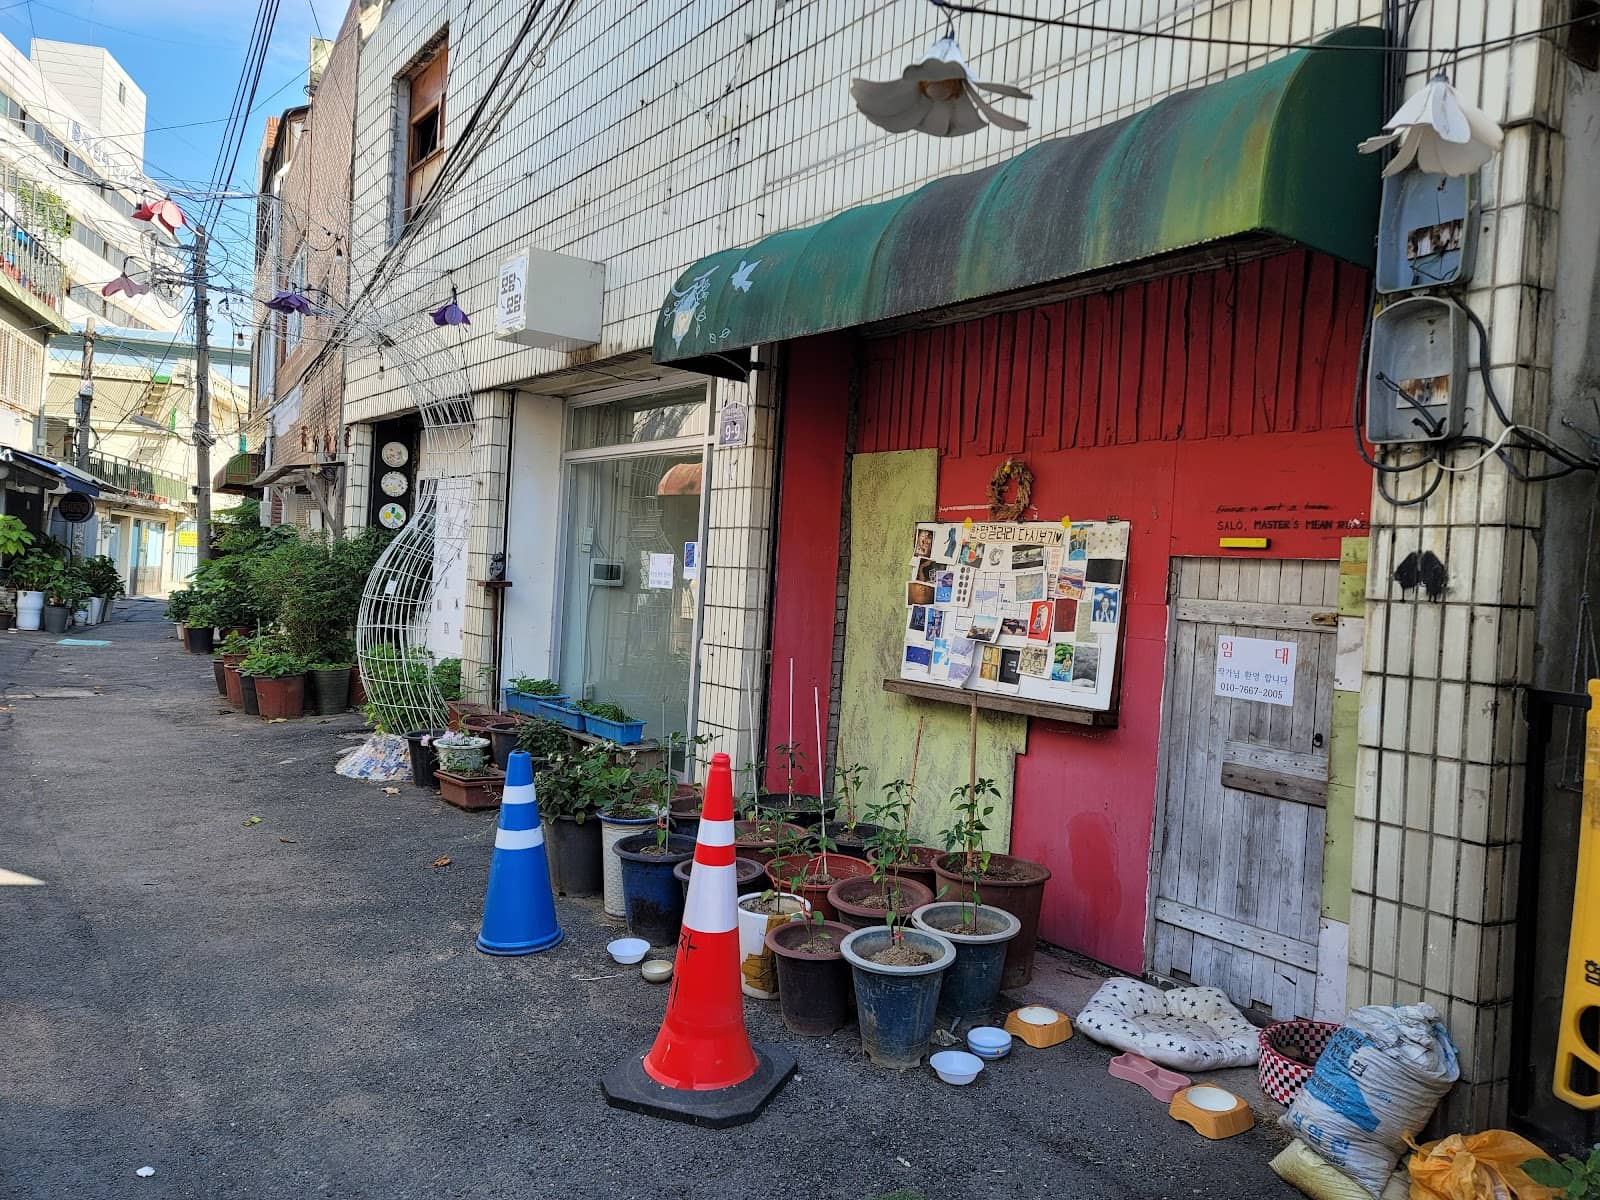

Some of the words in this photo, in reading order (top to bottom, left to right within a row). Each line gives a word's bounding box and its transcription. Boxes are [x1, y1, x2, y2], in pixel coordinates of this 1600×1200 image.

[725, 423, 740, 441] 9-9
[1018, 527, 1056, 544] 다시보기
[1264, 673, 1288, 685] 합니다
